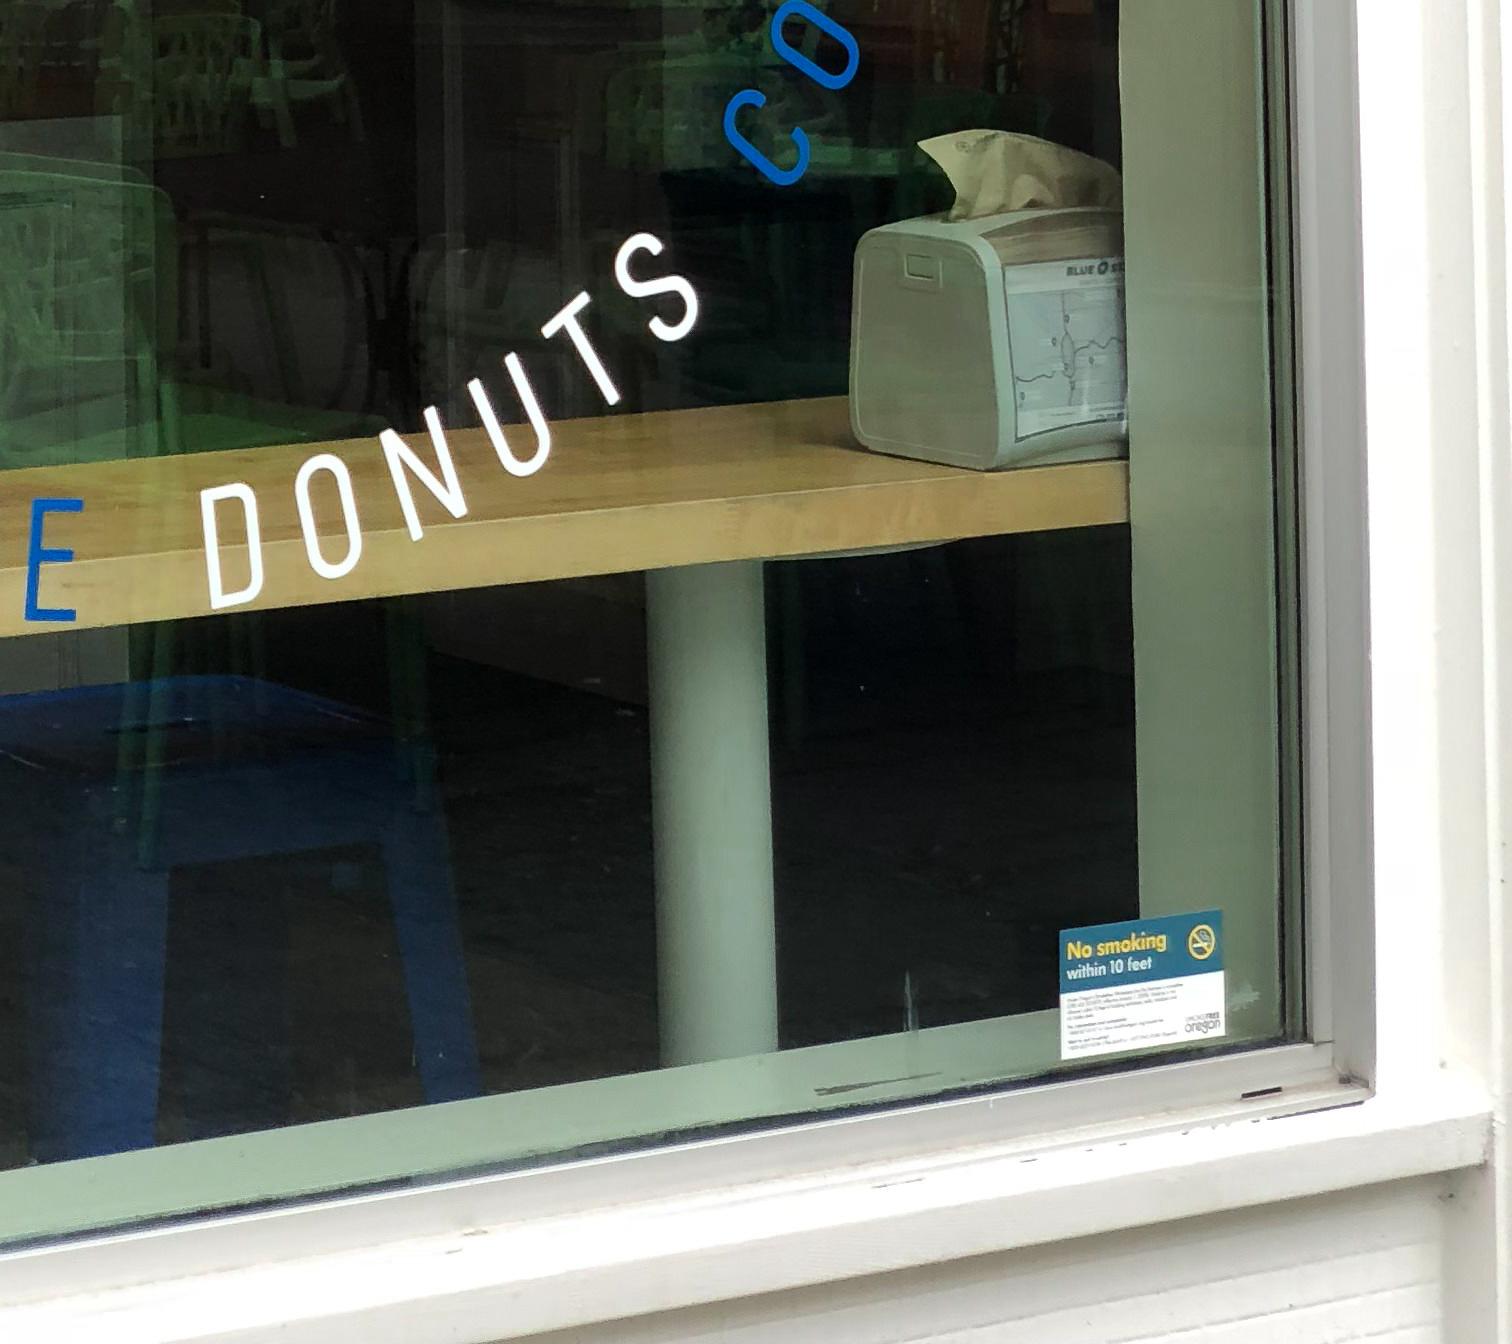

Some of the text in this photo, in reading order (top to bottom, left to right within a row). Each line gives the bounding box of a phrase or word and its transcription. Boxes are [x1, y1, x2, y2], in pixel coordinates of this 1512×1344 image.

[199, 232, 699, 610] DONUTS
[1067, 931, 1167, 960] No smoking
[1066, 956, 1153, 980] within 10 feet
[1184, 1019, 1221, 1034] oregon
